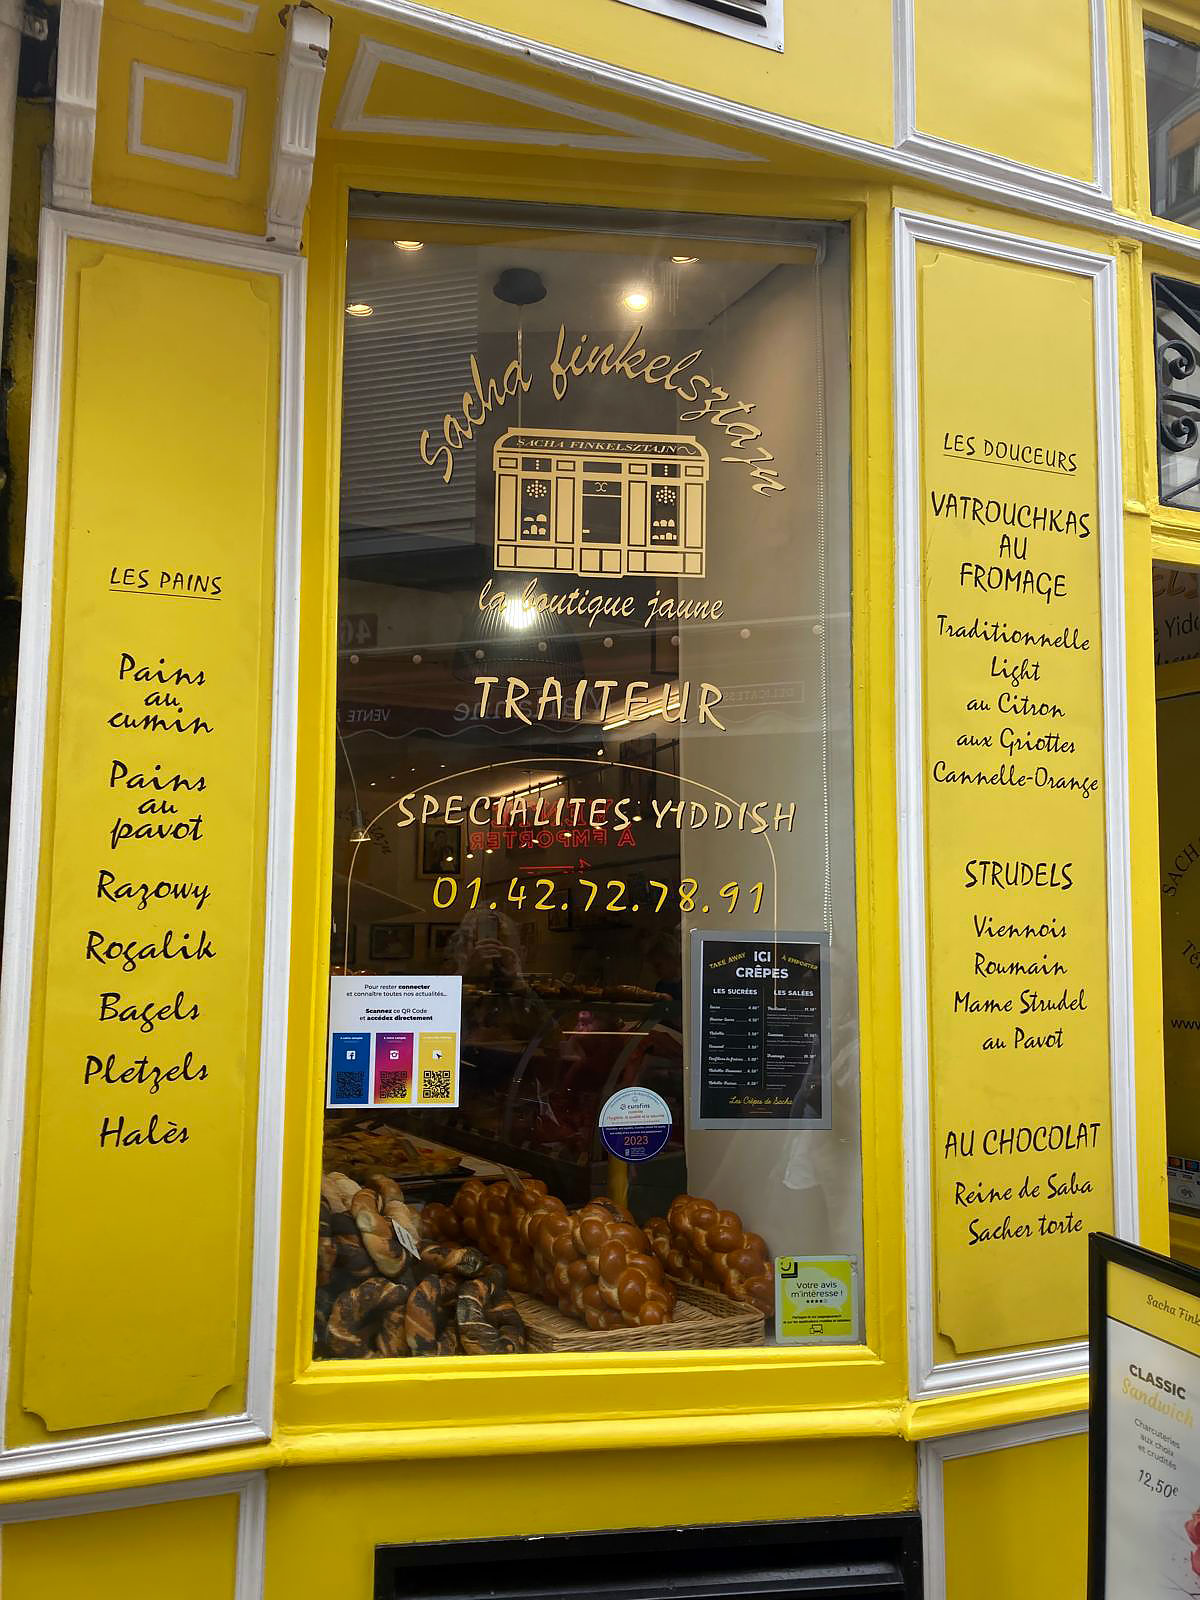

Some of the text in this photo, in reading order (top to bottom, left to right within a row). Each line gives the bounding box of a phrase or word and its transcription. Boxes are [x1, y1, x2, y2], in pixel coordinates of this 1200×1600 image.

[419, 353, 534, 485] Sacha
[516, 438, 679, 455] SACHA FINKELSZTAJN
[943, 432, 1078, 473] LES DOUCEURS
[931, 491, 1091, 539] VATROUCHKAS
[999, 534, 1028, 560] AU
[110, 567, 222, 595] LES PAINS
[960, 563, 1068, 604] FROMAGE
[478, 576, 725, 628] la boutique jaune
[937, 614, 1090, 651] Traditionnelle
[119, 653, 206, 686] Pains
[990, 655, 1040, 688] Light
[144, 691, 181, 706] au
[474, 676, 727, 731] TRAITEUR
[966, 692, 1065, 718] au Citron
[107, 707, 214, 734] cumin
[956, 727, 1076, 756] aux Griottes
[110, 760, 206, 791] Pains
[933, 760, 1099, 799] Cannelle-Orange
[137, 799, 178, 813] au
[397, 793, 630, 831] SPECIALITES
[651, 798, 797, 834] YIDDISH
[110, 815, 203, 849] pavot
[964, 860, 1073, 890] STRUDELS
[1163, 836, 1200, 896] SACH
[97, 869, 211, 910] Razowy
[432, 876, 766, 913] 01.42.72.78.91
[973, 914, 1067, 939] Viennois
[86, 930, 216, 972] Rogalik
[754, 951, 771, 962] ICI
[975, 952, 1067, 978] Roumain
[735, 964, 789, 979] CRÊPES
[712, 987, 726, 995] LES
[773, 989, 786, 997] LES
[953, 989, 1087, 1014] Mame Strudel
[99, 991, 200, 1032] Bagels
[982, 1027, 1063, 1051] au Pavot
[84, 1051, 208, 1094] Pletzels
[100, 1114, 190, 1147] Halès
[624, 1135, 649, 1146] 2023
[944, 1122, 1101, 1159] AU CHOCOLAT
[954, 1172, 1093, 1207] Reine de Saba
[968, 1211, 1083, 1246] Sacher torte
[796, 1281, 818, 1289] Votre
[1146, 1294, 1176, 1316] Sacha
[1129, 1364, 1186, 1400] CLASSIC
[1122, 1376, 1194, 1429] Sandwich
[1134, 1418, 1180, 1449] Charcuteries
[1140, 1433, 1174, 1457] aux choix
[1138, 1444, 1177, 1470] et crudités
[1138, 1469, 1179, 1498] 12,50€
